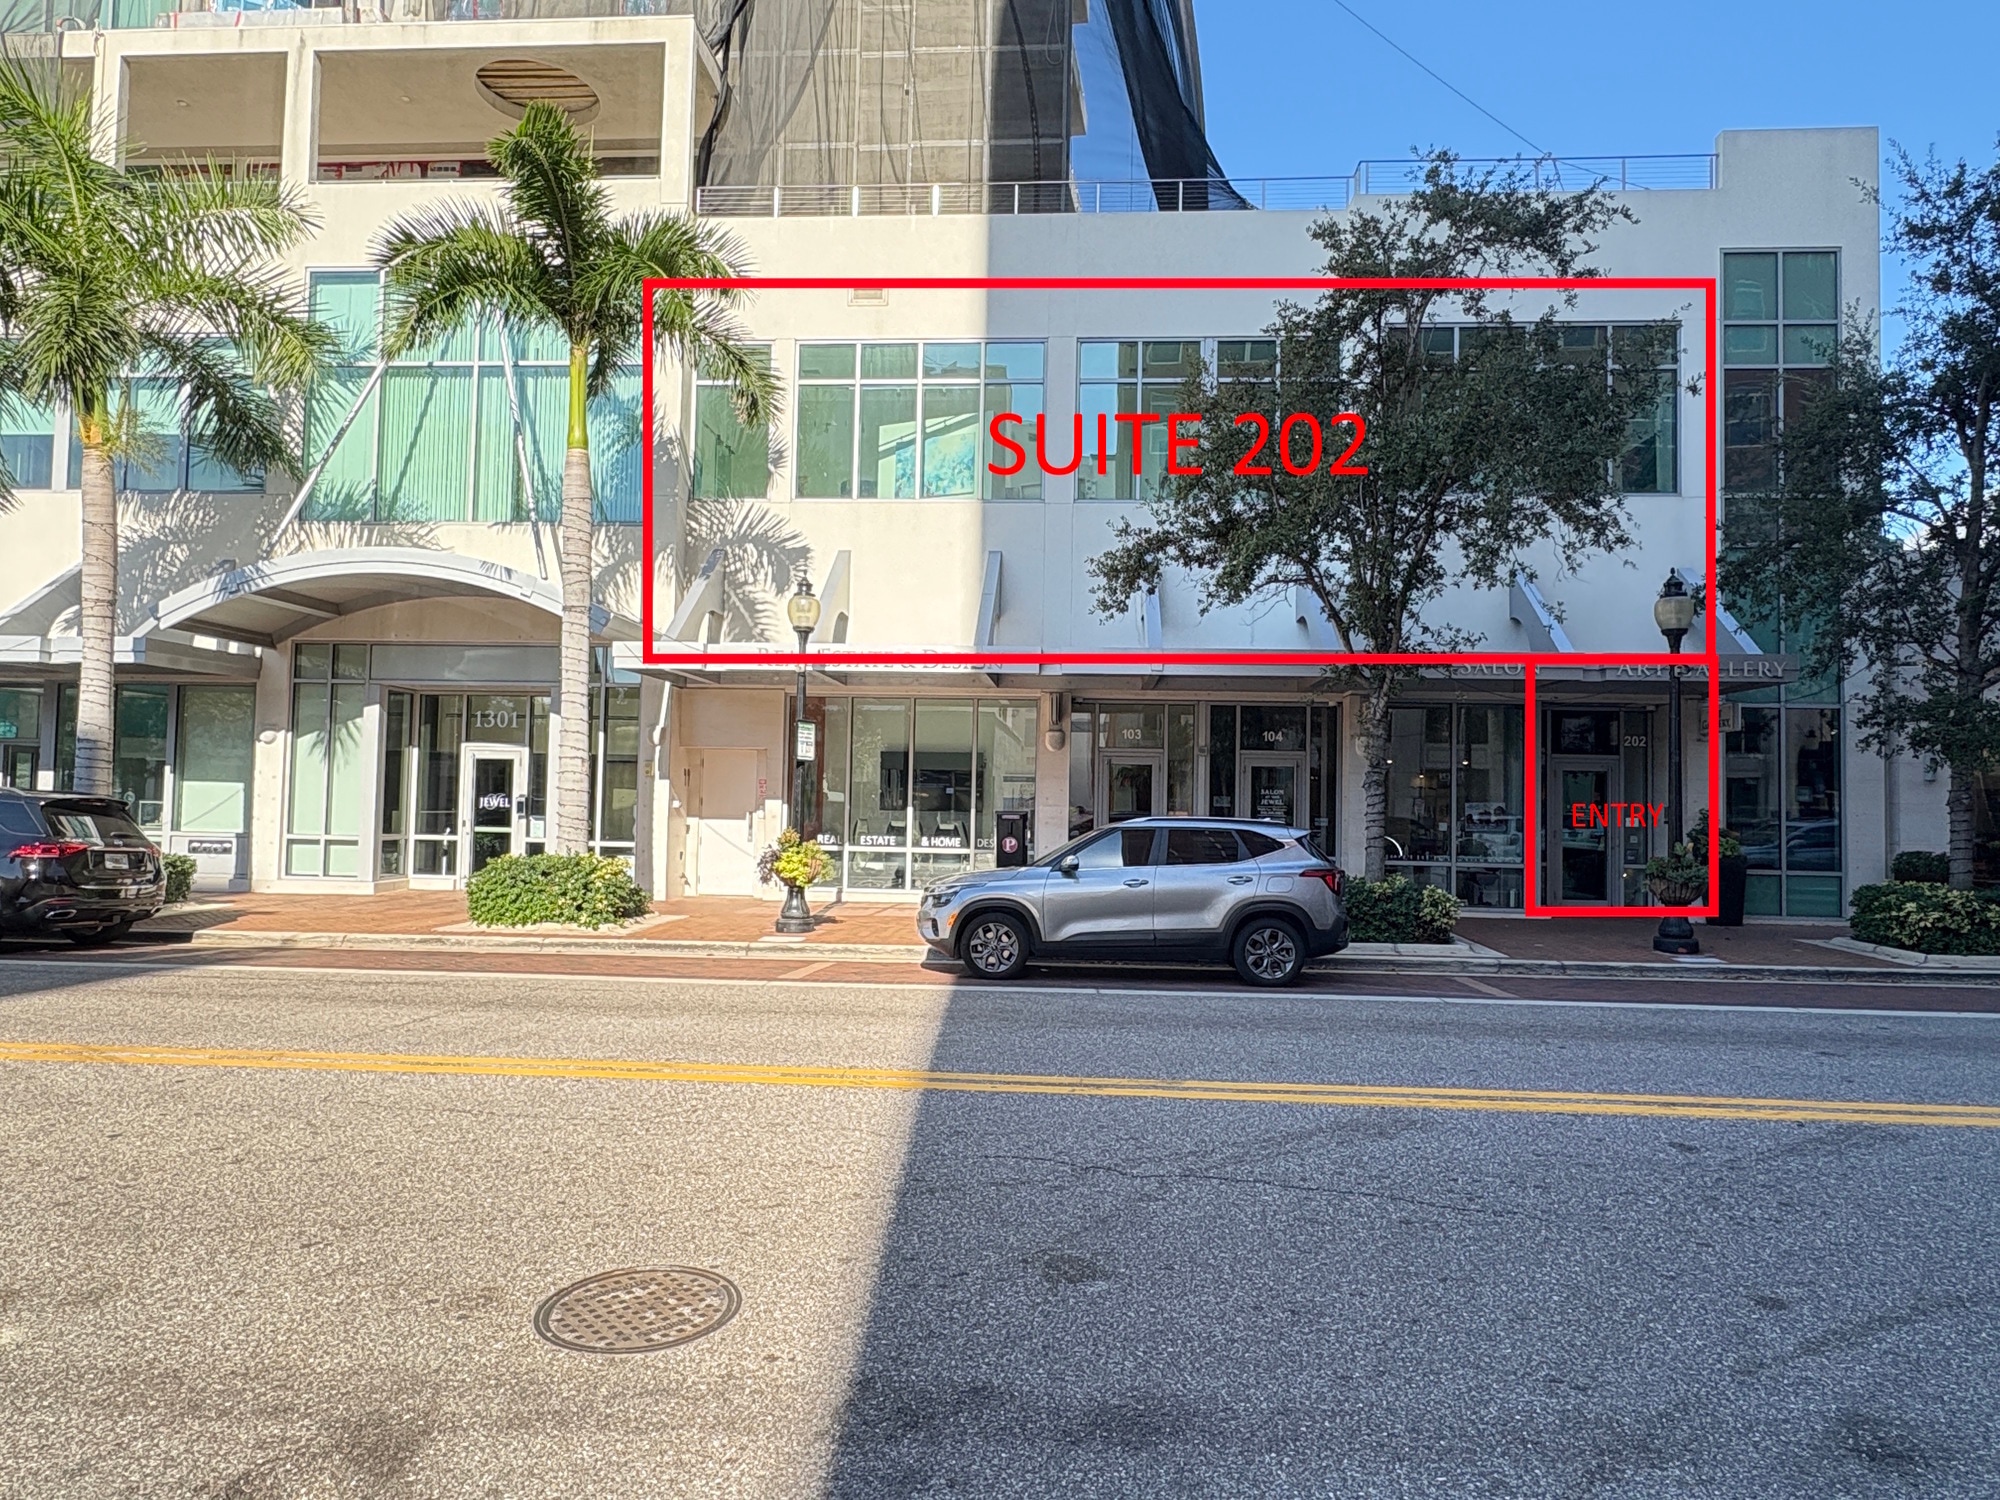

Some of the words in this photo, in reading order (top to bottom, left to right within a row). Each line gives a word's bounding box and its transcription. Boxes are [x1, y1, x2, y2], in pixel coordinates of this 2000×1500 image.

[1673, 661, 1788, 678] GALERY
[474, 710, 519, 729] 1301
[1121, 728, 1142, 740] 103
[1262, 730, 1284, 742] 104
[1623, 735, 1647, 747] 202
[479, 794, 511, 810] JEWEL
[817, 834, 843, 846] REAL
[860, 835, 897, 847] ESTATE
[921, 836, 930, 847] &
[931, 837, 962, 848] HOME
